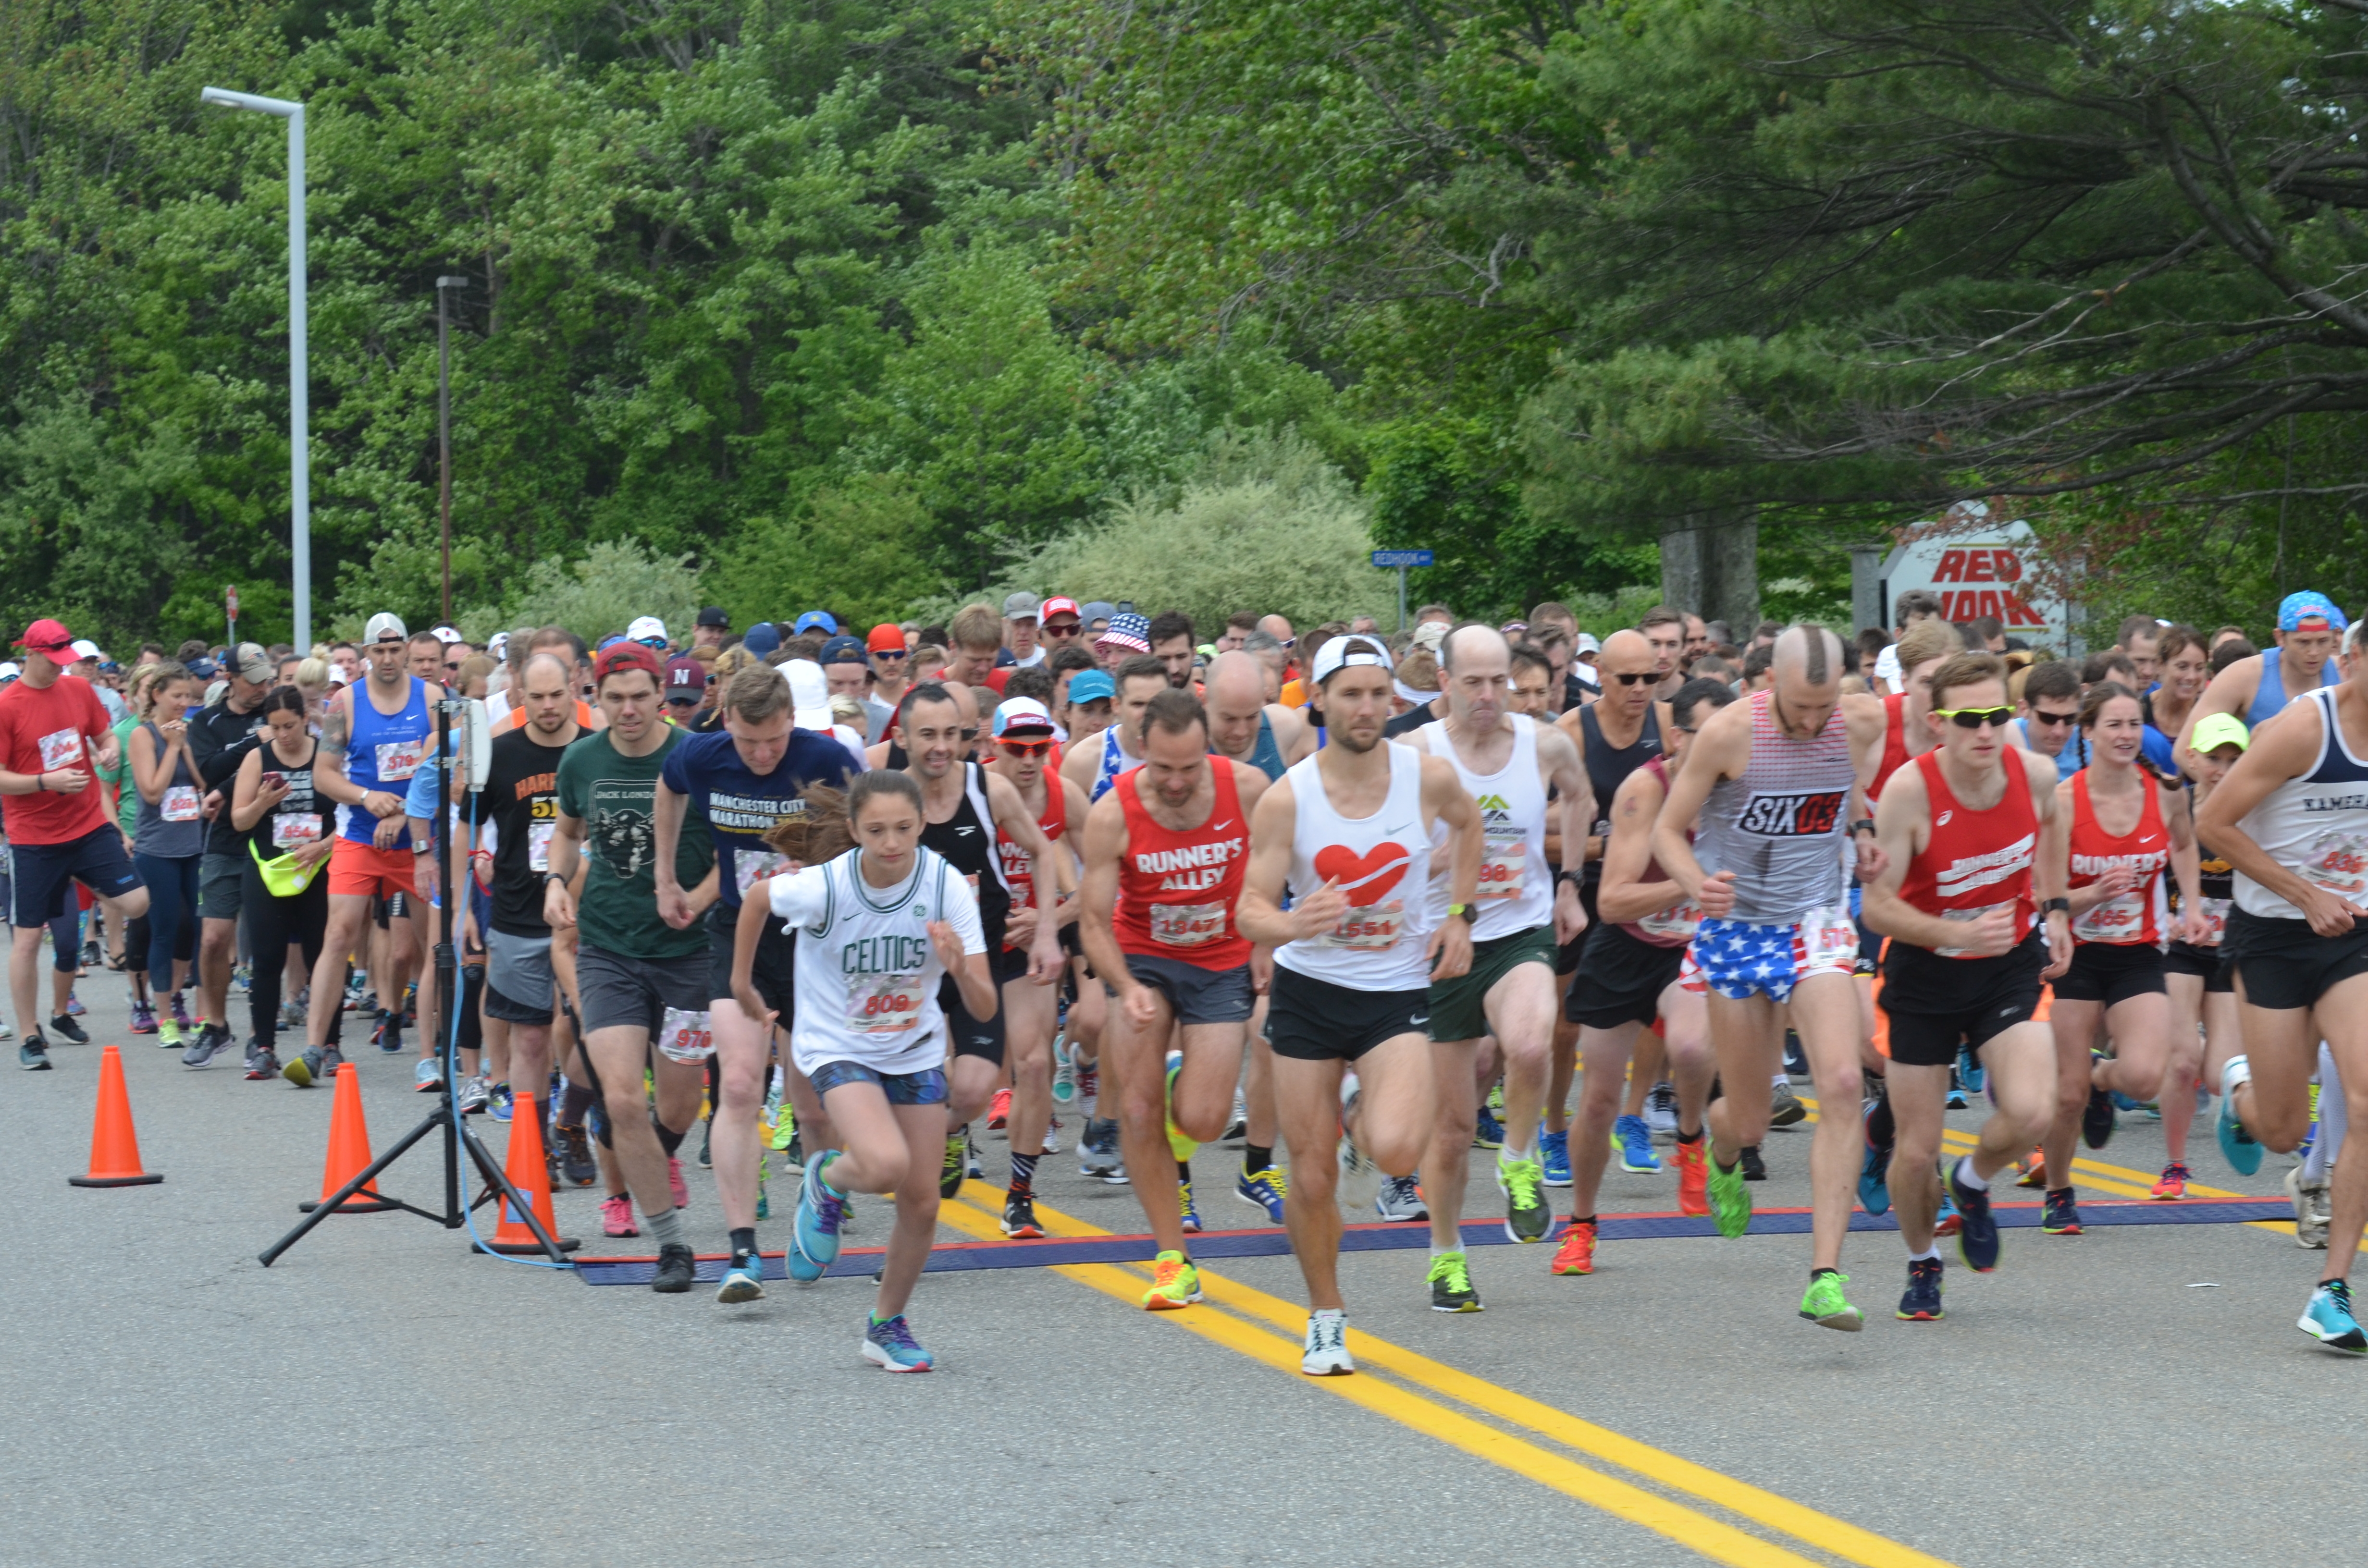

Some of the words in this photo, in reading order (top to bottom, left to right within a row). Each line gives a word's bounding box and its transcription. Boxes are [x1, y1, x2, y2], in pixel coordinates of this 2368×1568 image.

[1374, 553, 1419, 564] REDHOOK
[1931, 550, 2022, 583] RED
[673, 669, 691, 685] N
[388, 755, 413, 770] 379
[709, 792, 779, 814] MANCHESTER
[779, 798, 806, 814] CITY
[709, 809, 775, 829] MARATHON
[284, 826, 310, 838] 954
[1135, 837, 1243, 873] RUNNER'S
[1159, 866, 1228, 890] ALLEY
[1161, 919, 1217, 935] 1347
[2090, 909, 2127, 926] 465
[842, 935, 926, 974] CELTICS
[865, 994, 909, 1015] 809
